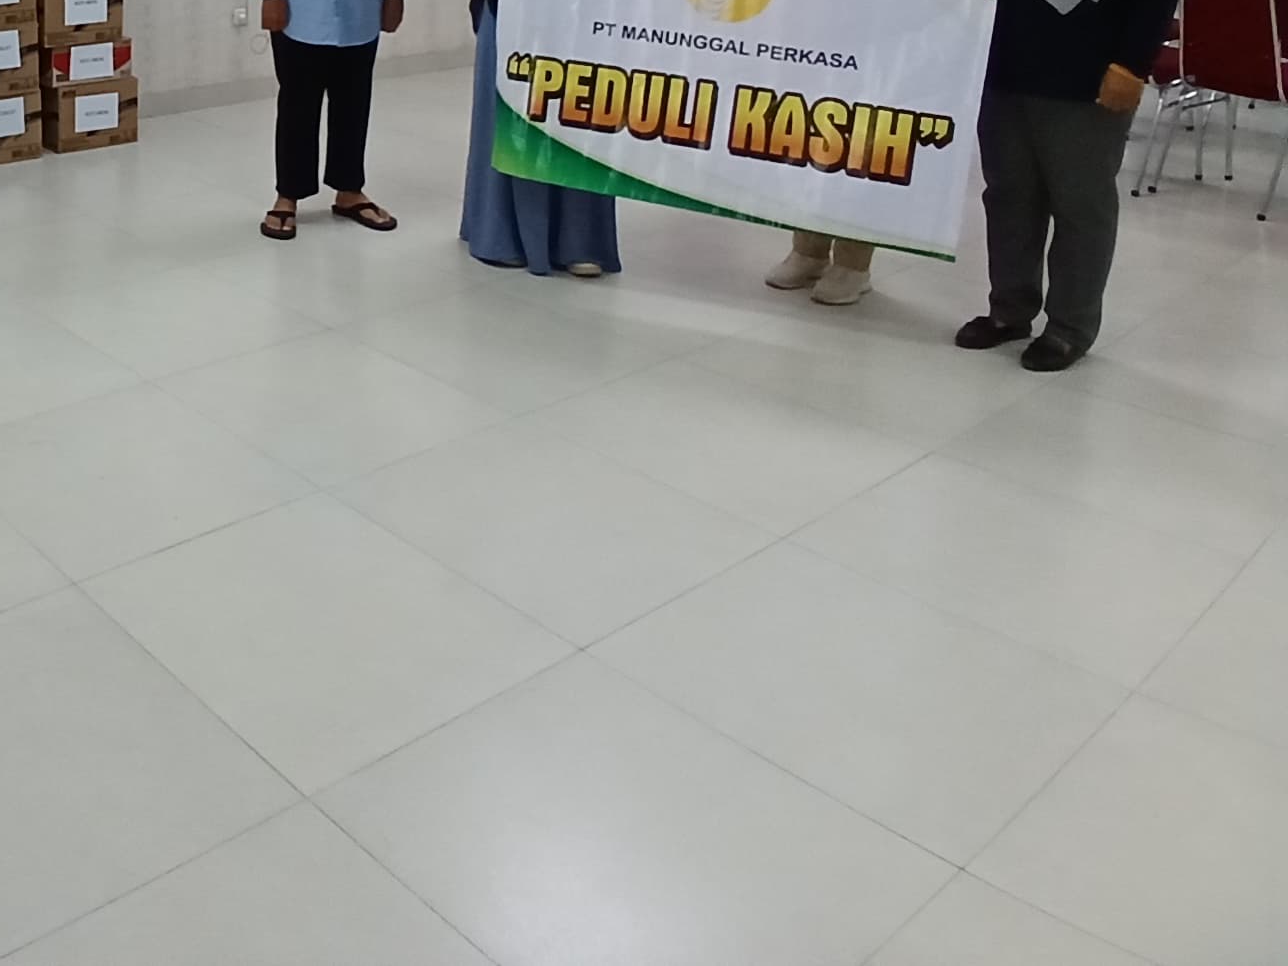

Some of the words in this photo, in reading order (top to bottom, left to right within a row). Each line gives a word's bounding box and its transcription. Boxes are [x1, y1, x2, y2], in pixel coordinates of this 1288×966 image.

[591, 20, 616, 38] PT
[621, 25, 750, 57] MANUNGGAL
[756, 43, 859, 71] PERKASA
